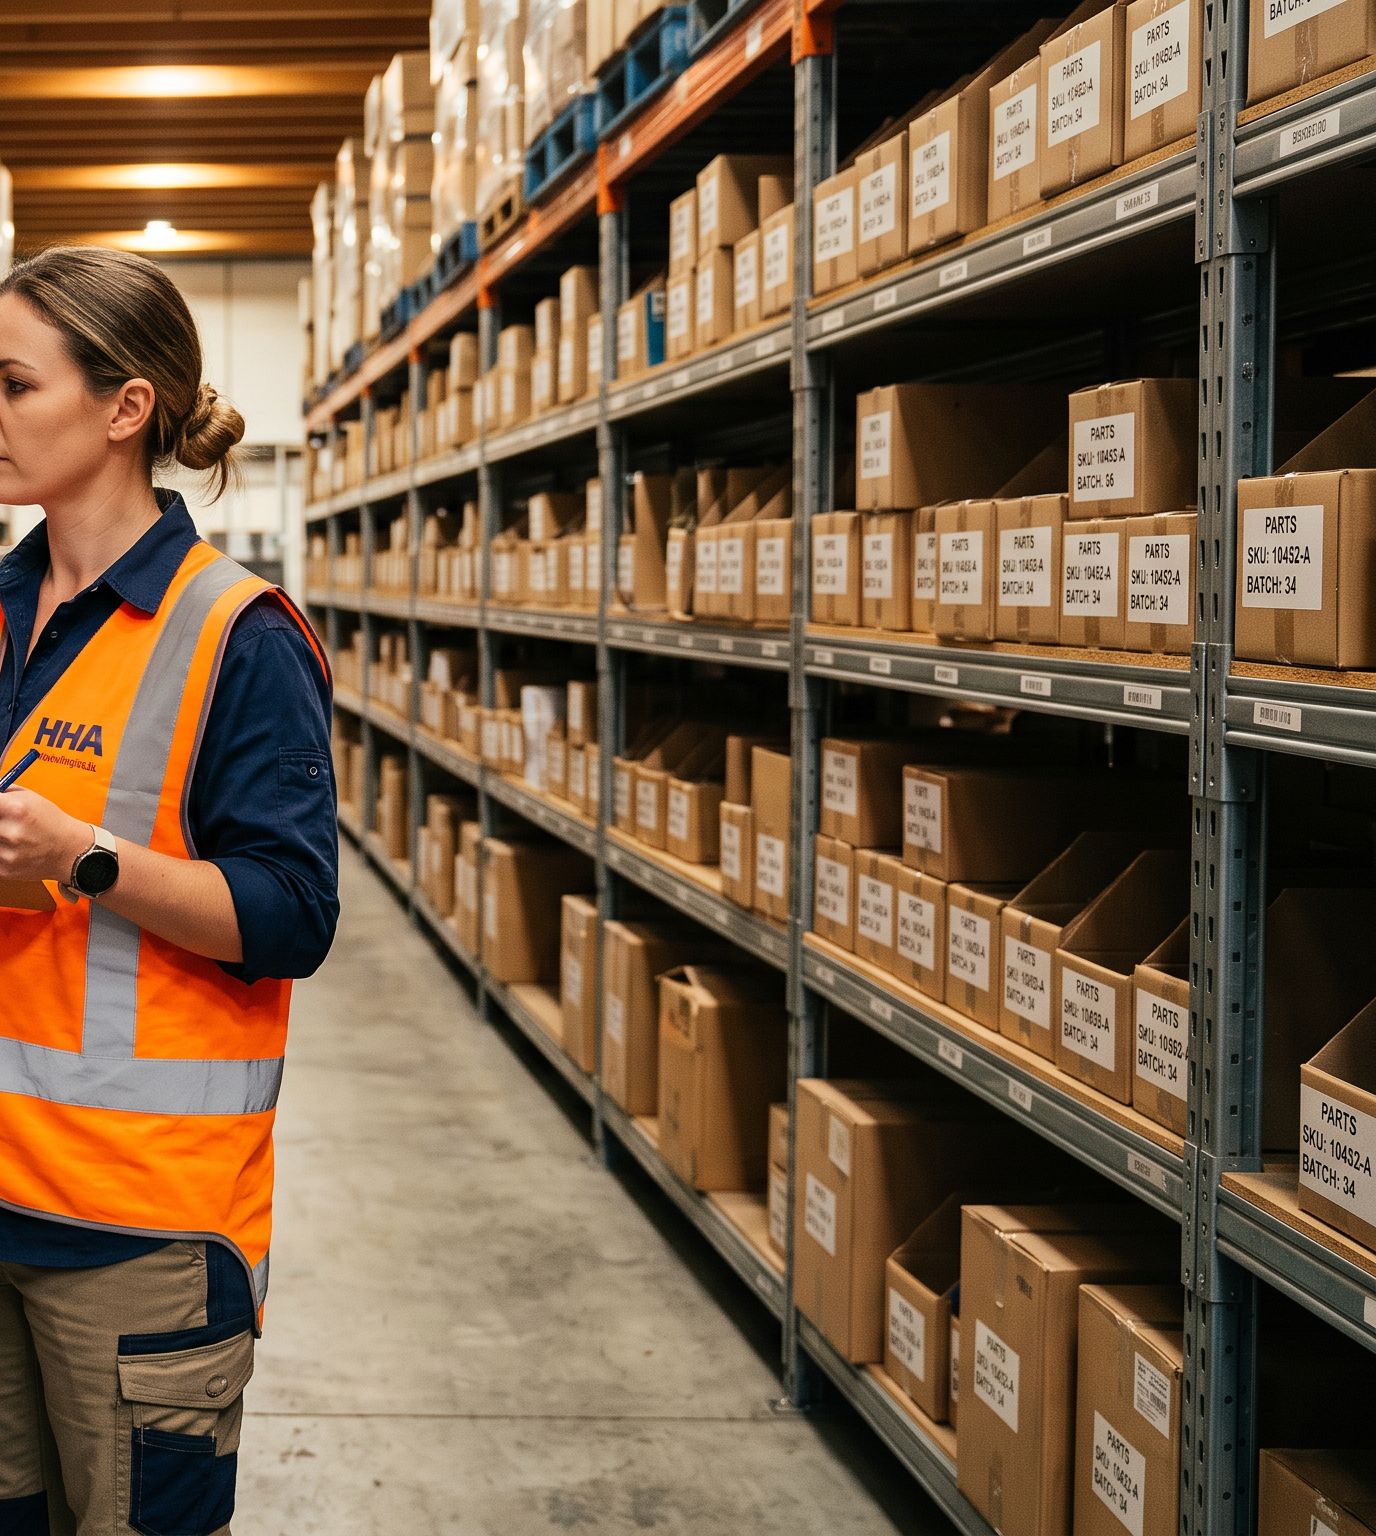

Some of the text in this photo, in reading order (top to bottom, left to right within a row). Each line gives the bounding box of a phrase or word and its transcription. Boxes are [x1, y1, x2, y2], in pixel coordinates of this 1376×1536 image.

[1146, 19, 1170, 46] PARTS
[1090, 424, 1115, 441] PARTS
[1265, 515, 1297, 534] PARTS
[1078, 540, 1101, 556] PARTS
[1144, 543, 1170, 559] PARTS
[1247, 546, 1270, 564] SKU:
[1247, 575, 1297, 595] BATCH: 34
[1092, 589, 1101, 605] 34
[1159, 594, 1169, 611] 34
[34, 717, 102, 756] HHA
[1076, 979, 1099, 1003] PARTS
[1151, 1002, 1179, 1029] PARTS
[1138, 1048, 1178, 1083] BATCH: 34
[1321, 1101, 1357, 1136] PARTS
[1302, 1124, 1327, 1154] SKU:
[1302, 1152, 1356, 1199] BATCH: 34
